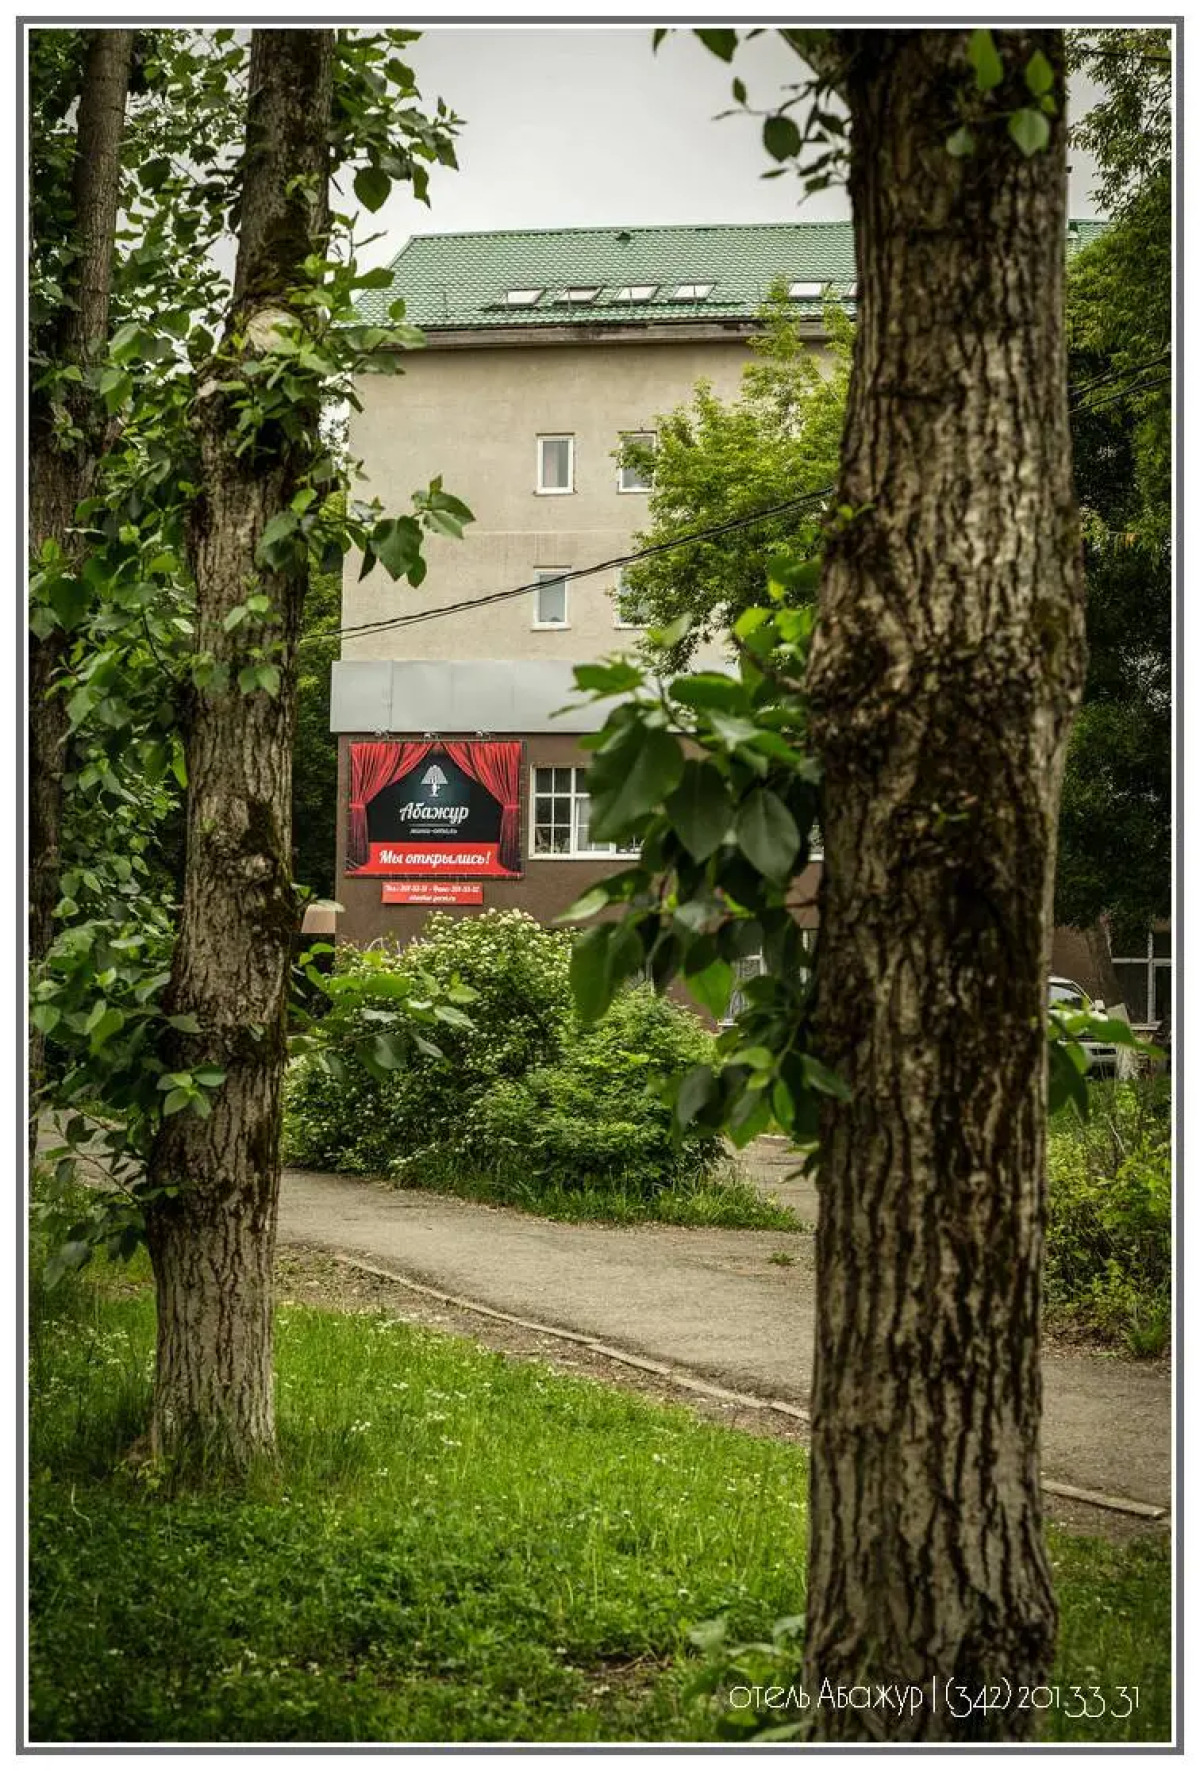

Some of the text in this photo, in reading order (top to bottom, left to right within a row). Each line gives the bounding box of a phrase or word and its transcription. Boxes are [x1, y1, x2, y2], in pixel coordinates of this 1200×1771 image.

[399, 802, 469, 824] Абажур
[379, 850, 491, 868] Мы открылись!
